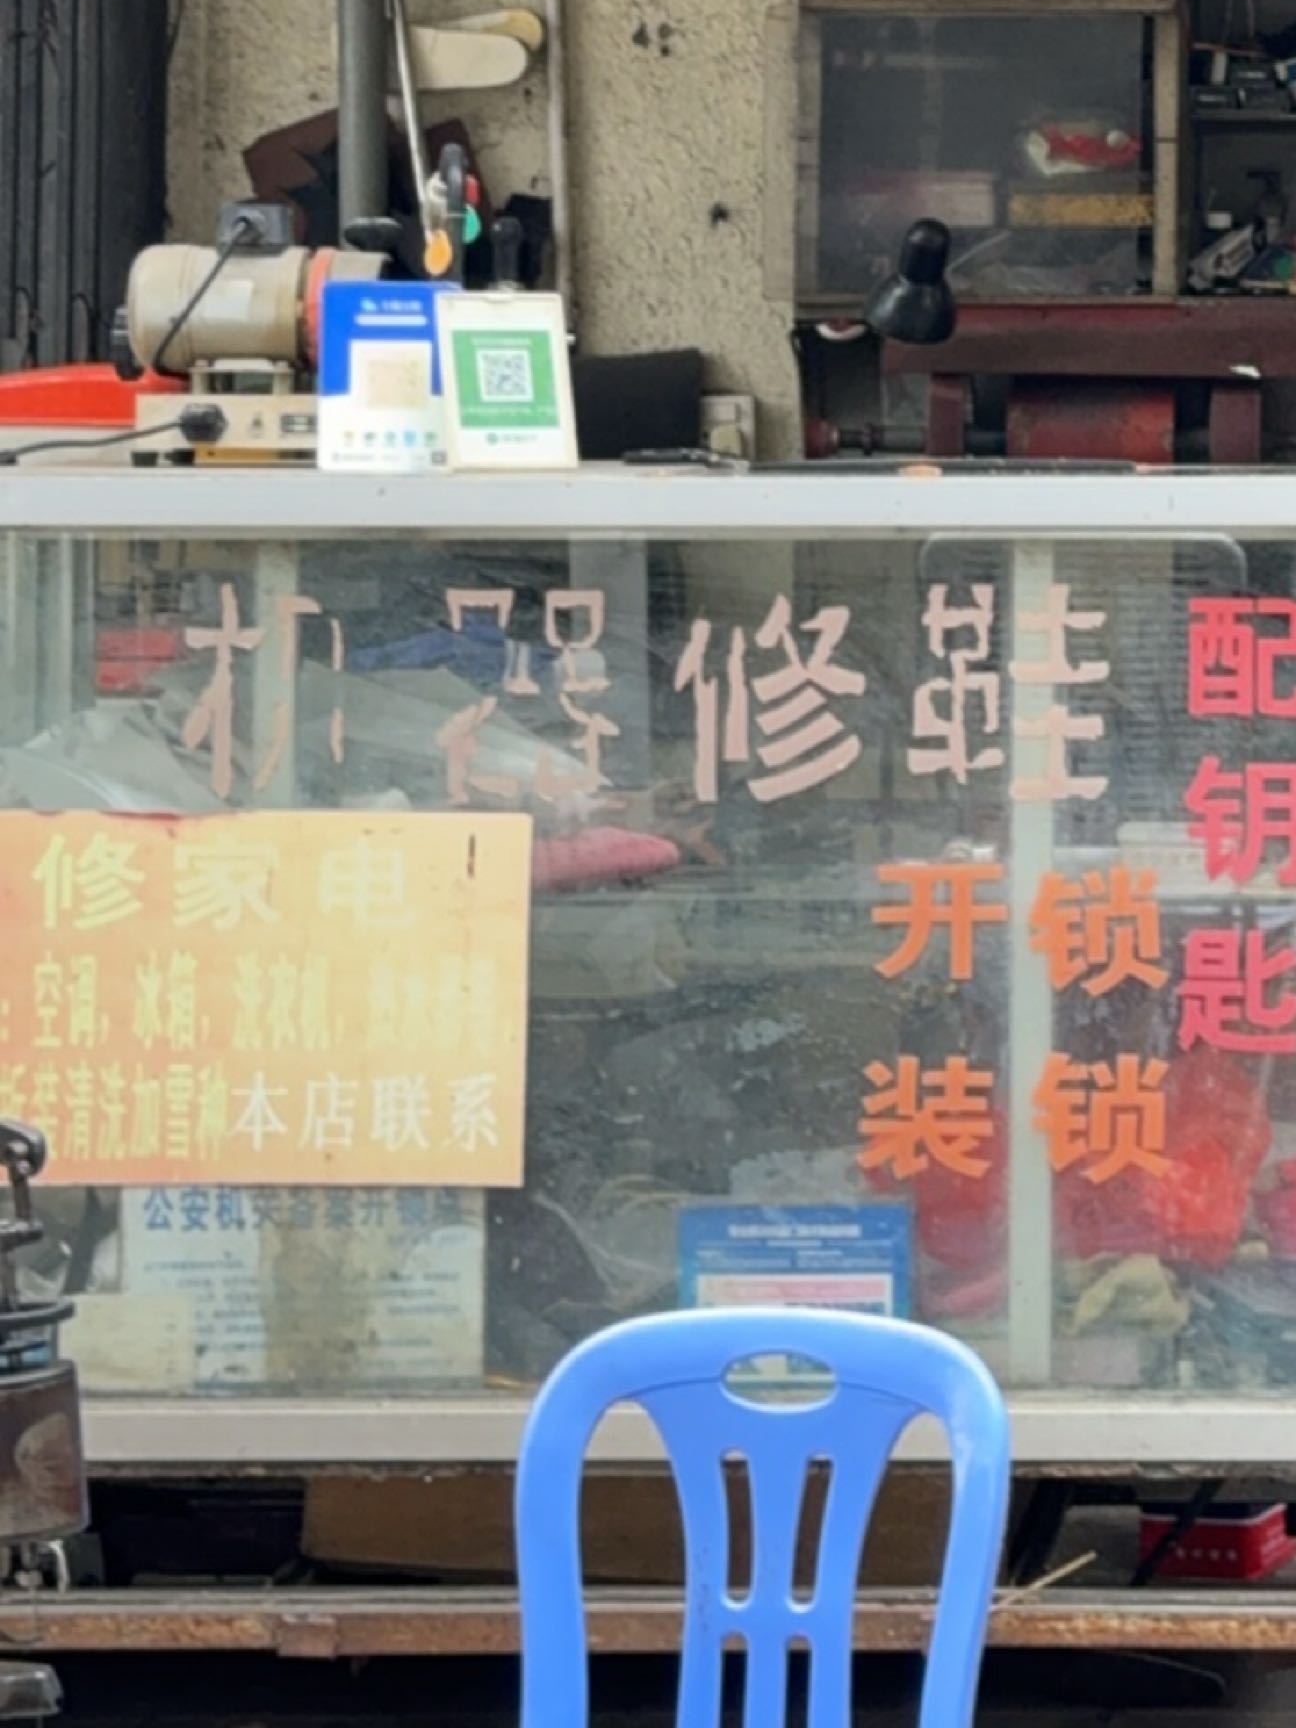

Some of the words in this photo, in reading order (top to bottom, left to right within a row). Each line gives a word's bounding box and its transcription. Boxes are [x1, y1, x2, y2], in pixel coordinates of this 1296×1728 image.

[33, 829, 416, 932] 修家电
[871, 863, 1170, 998] 开锁
[857, 1051, 1177, 1185] 装锁
